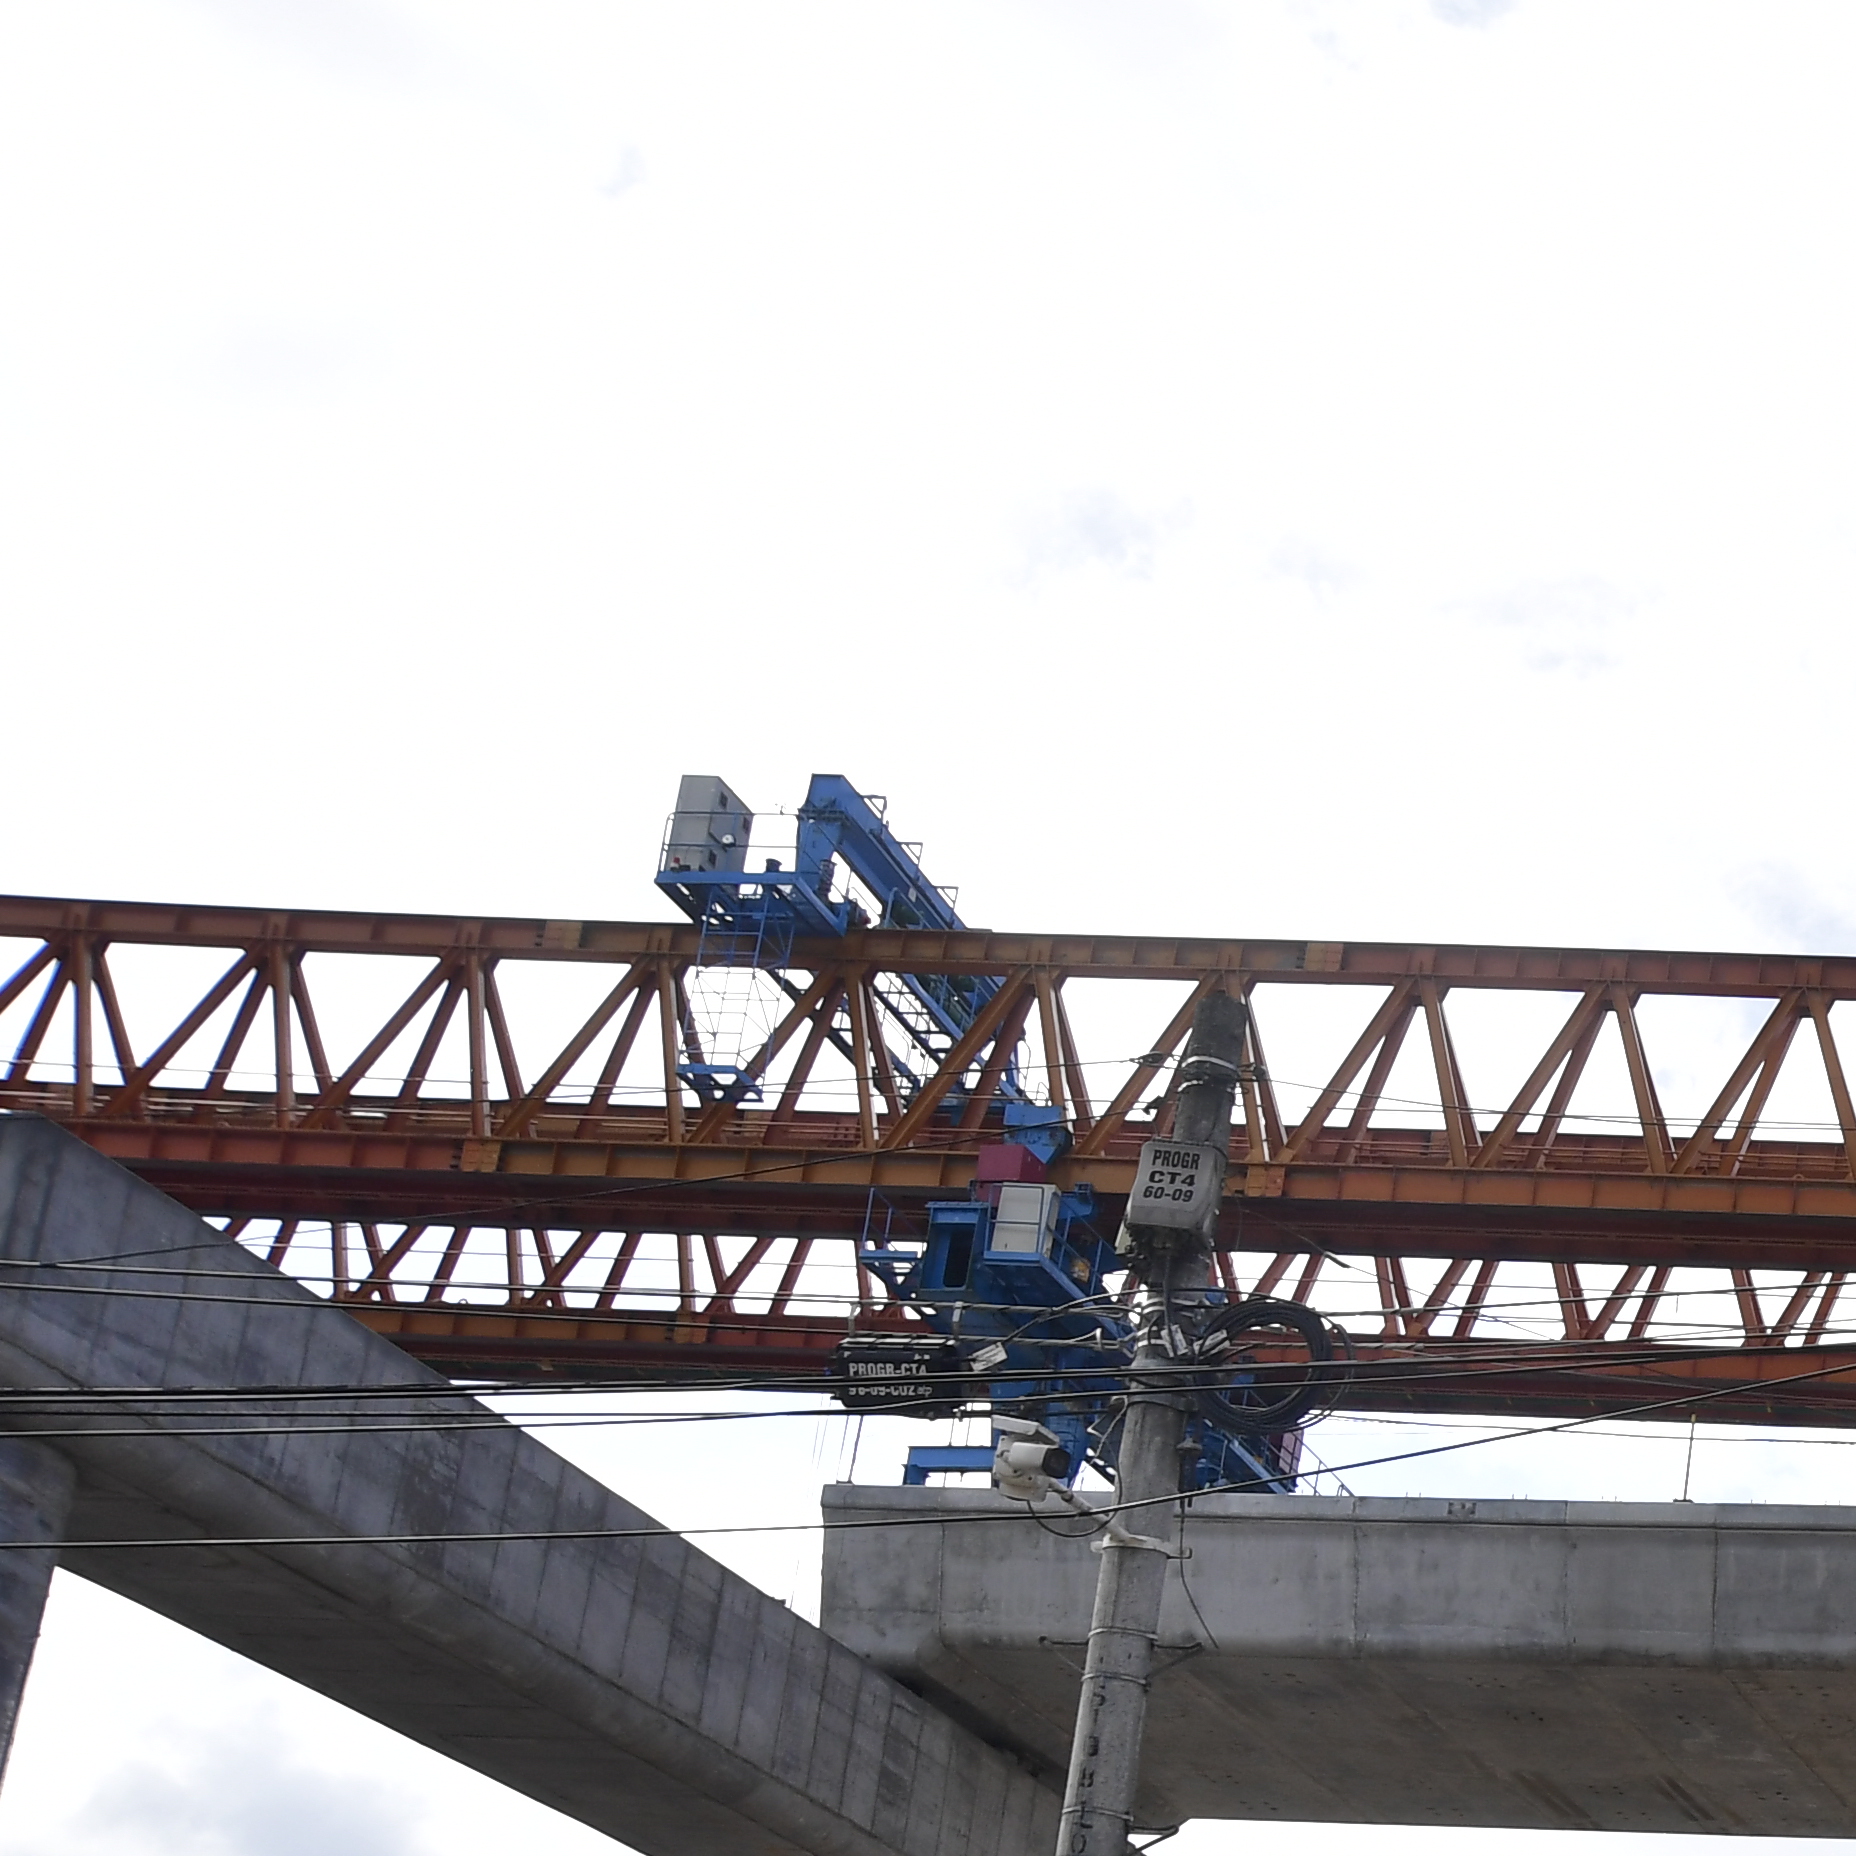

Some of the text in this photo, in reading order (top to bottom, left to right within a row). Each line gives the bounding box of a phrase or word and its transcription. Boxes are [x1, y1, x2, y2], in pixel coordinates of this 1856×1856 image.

[1151, 1149, 1200, 1170] PROGR
[1148, 1170, 1196, 1187] CT4
[1143, 1185, 1194, 1203] 60-09
